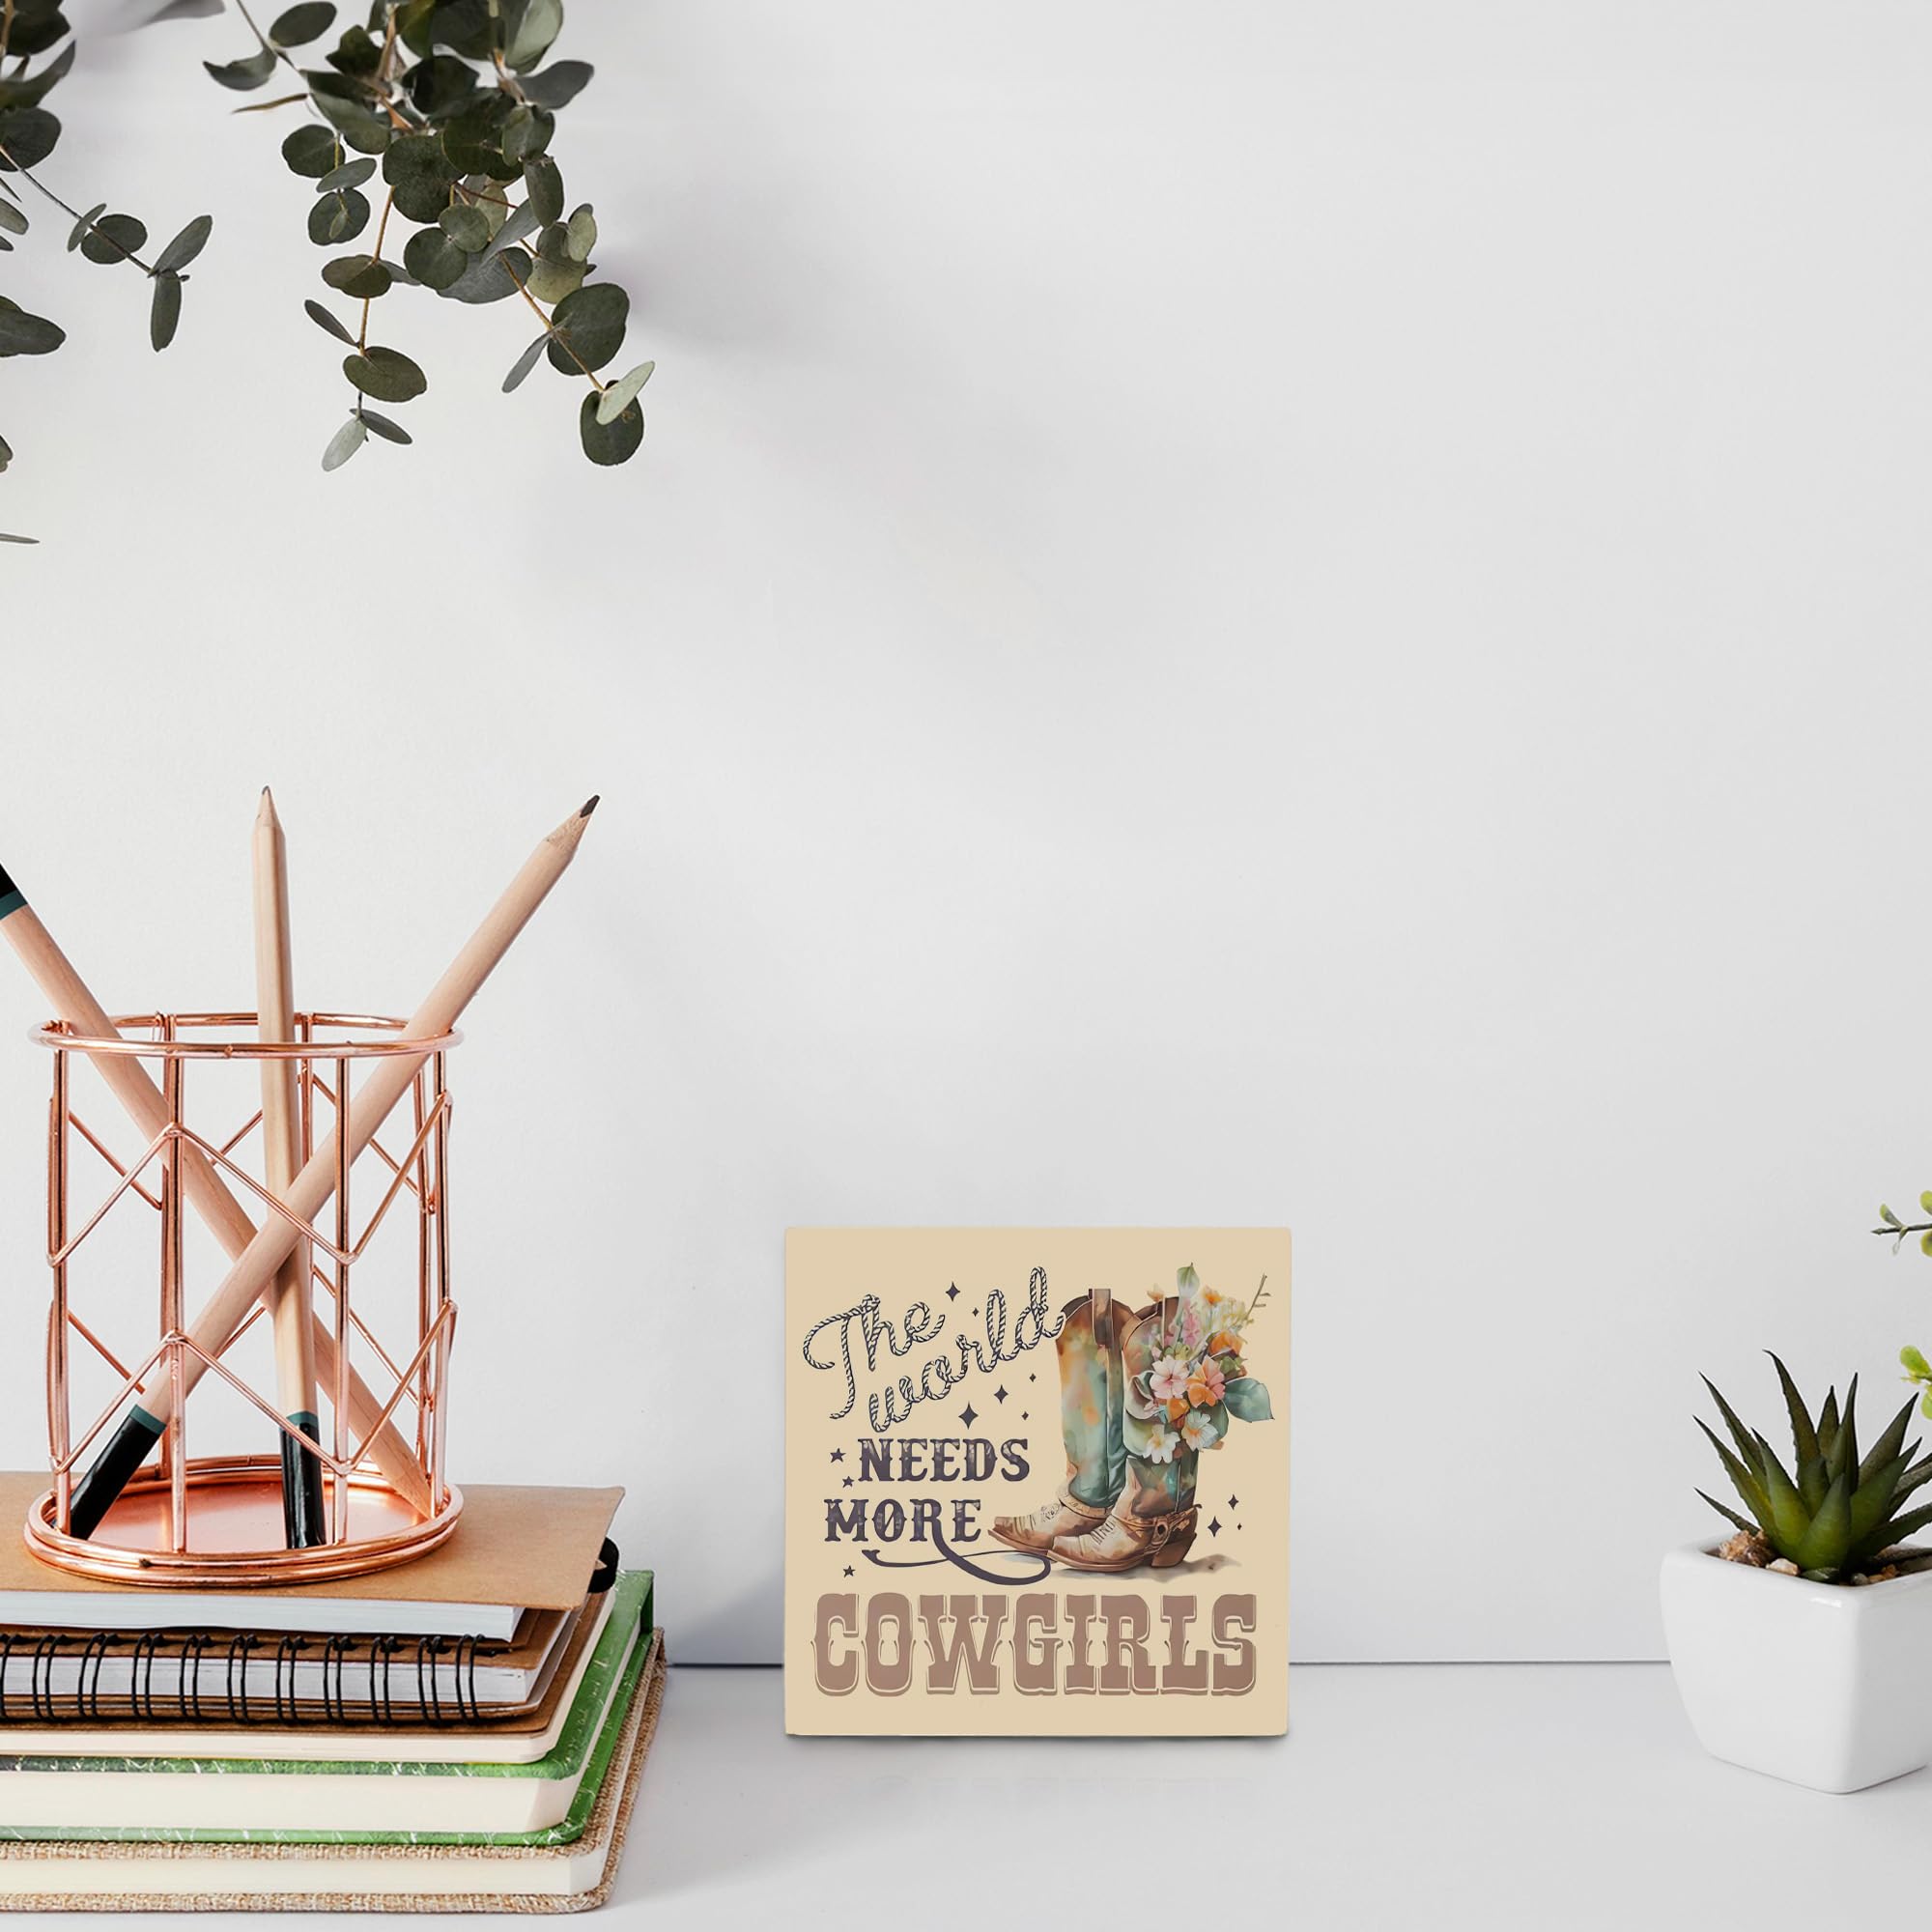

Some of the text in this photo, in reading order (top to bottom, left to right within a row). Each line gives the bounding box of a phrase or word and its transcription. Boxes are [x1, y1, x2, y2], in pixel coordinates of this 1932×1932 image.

[803, 1293, 946, 1420] The
[868, 1266, 1065, 1433] world
[858, 1437, 1031, 1482] NEEDS
[810, 1592, 1257, 1696] COWGIRLS
